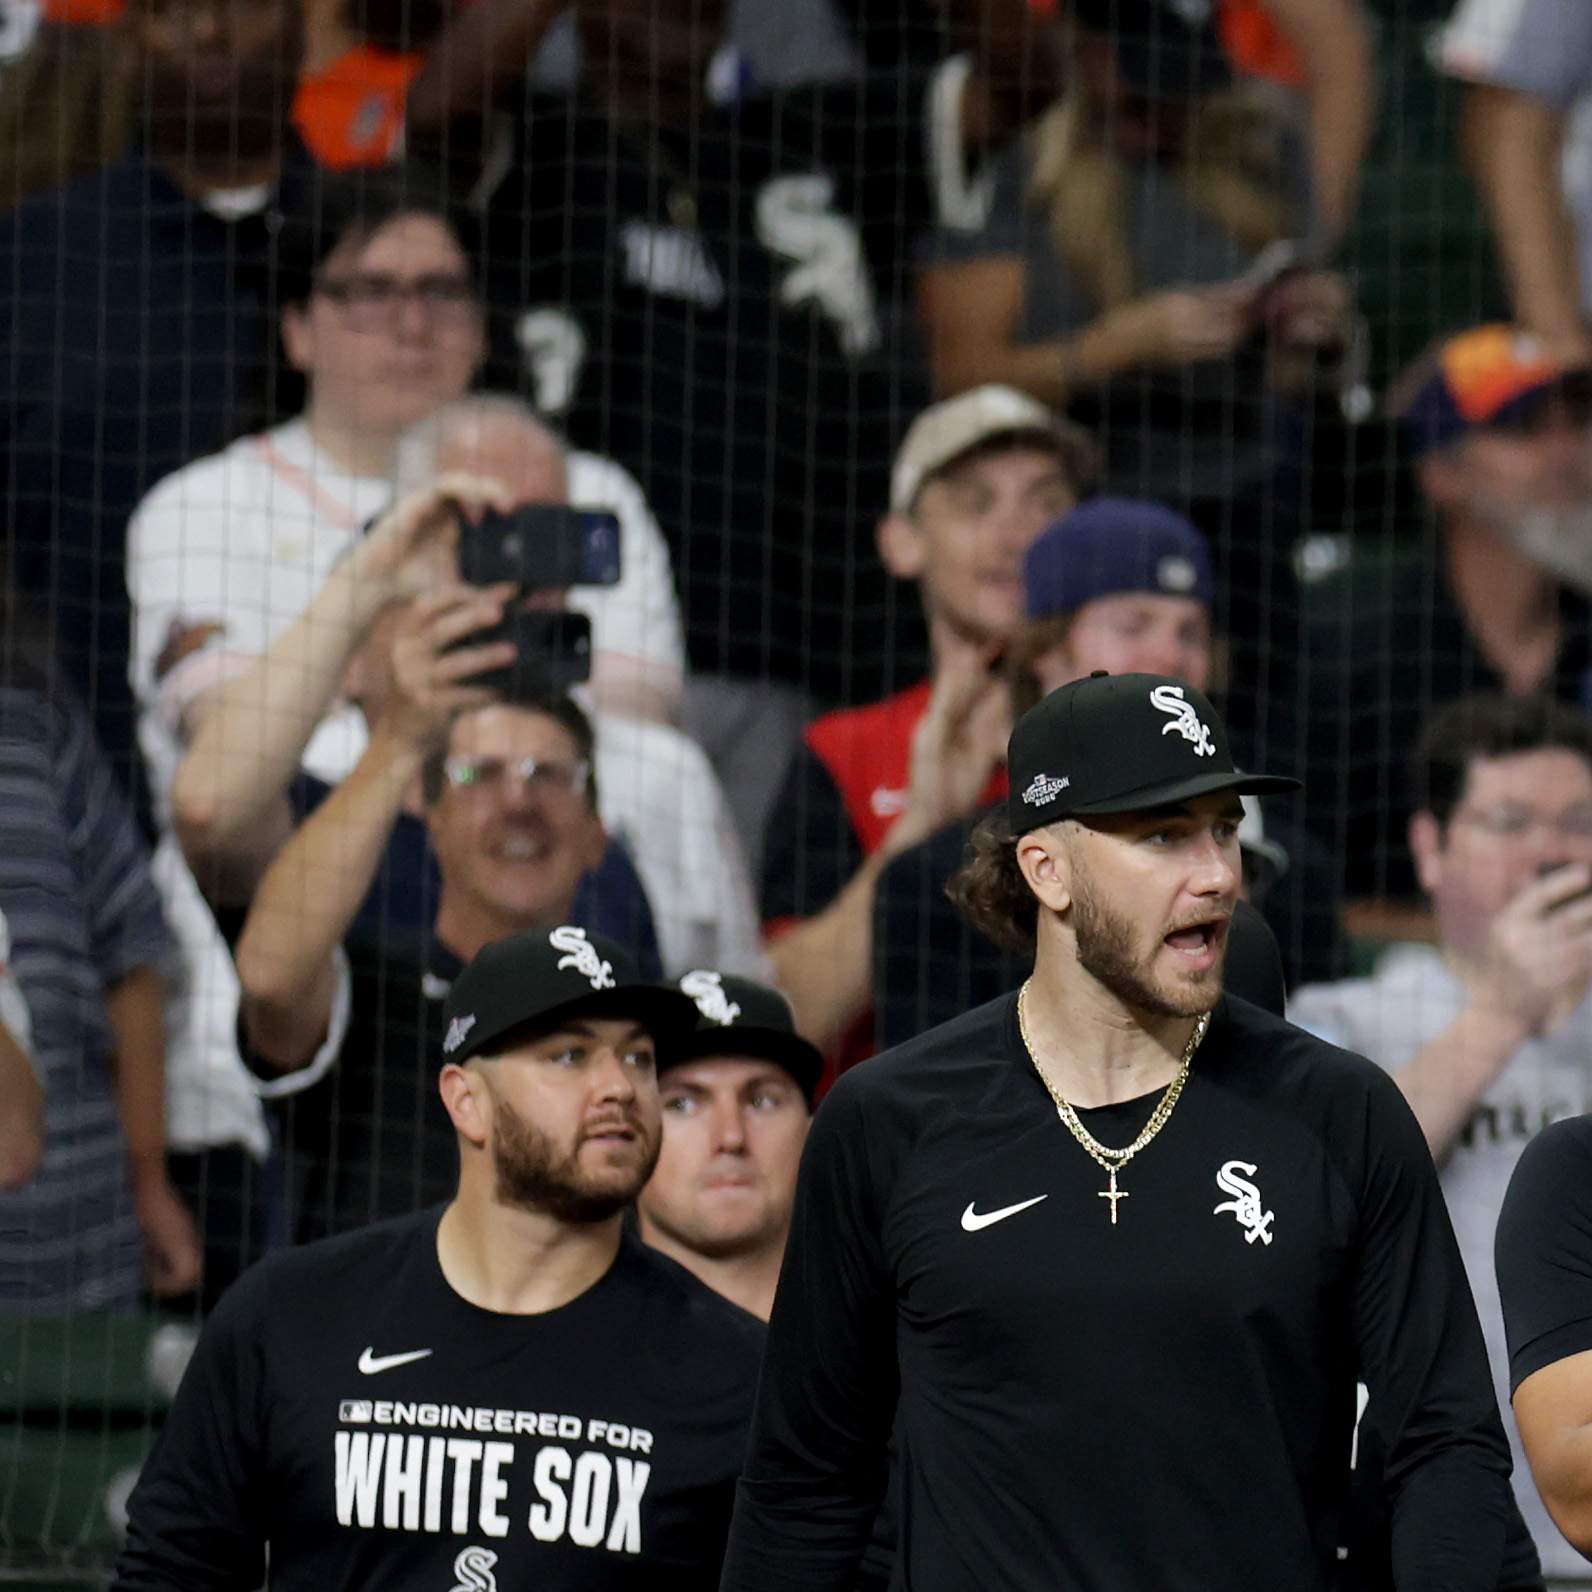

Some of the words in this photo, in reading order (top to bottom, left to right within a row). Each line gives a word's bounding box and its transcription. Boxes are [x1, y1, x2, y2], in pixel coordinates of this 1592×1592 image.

[374, 1400, 582, 1440] ENGINEERED
[587, 1418, 653, 1454] FOR
[335, 1430, 515, 1538] WHITE
[528, 1445, 651, 1554] SOX
